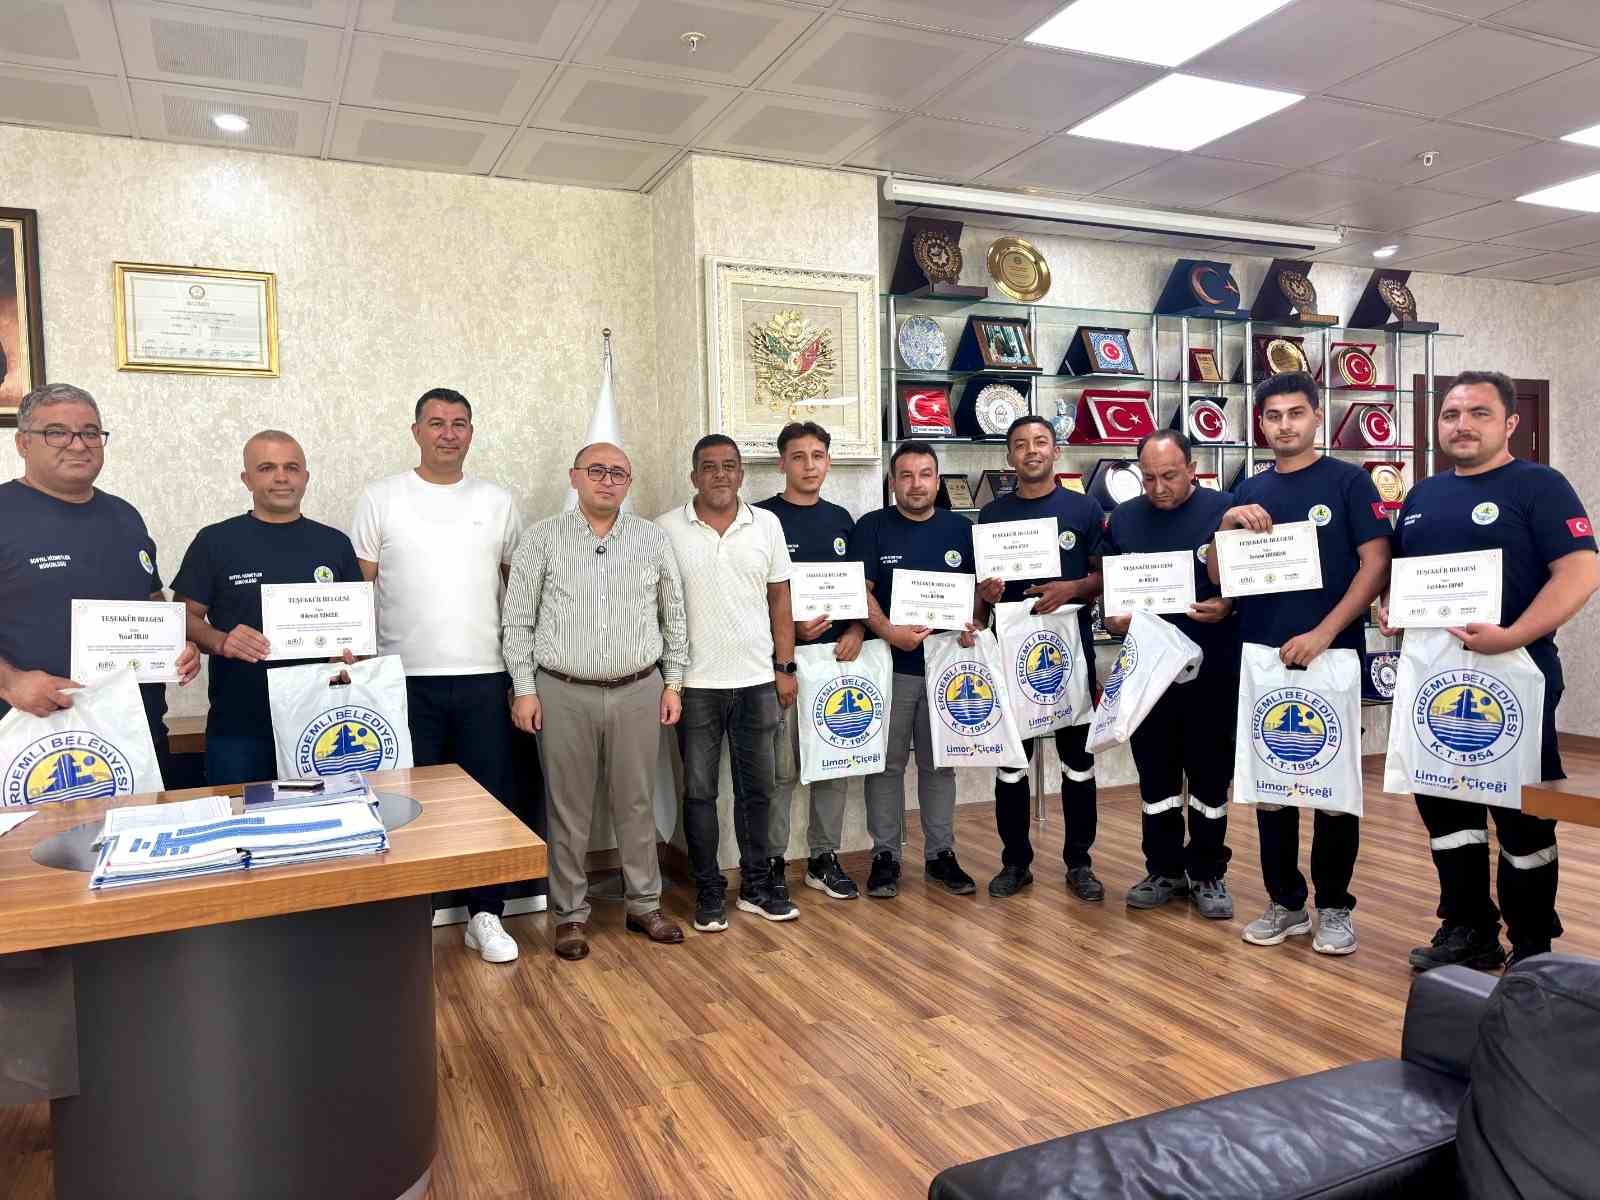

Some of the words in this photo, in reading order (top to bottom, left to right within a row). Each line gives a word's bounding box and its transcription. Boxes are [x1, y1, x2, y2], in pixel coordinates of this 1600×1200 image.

[1253, 690, 1283, 740] ERDEMLİ
[1285, 690, 1338, 748] BELEDİYESİ
[1462, 672, 1518, 737] BELEDİYESİ
[8, 743, 47, 806] RDEMLİ
[51, 735, 131, 791] BELEDİYESİ
